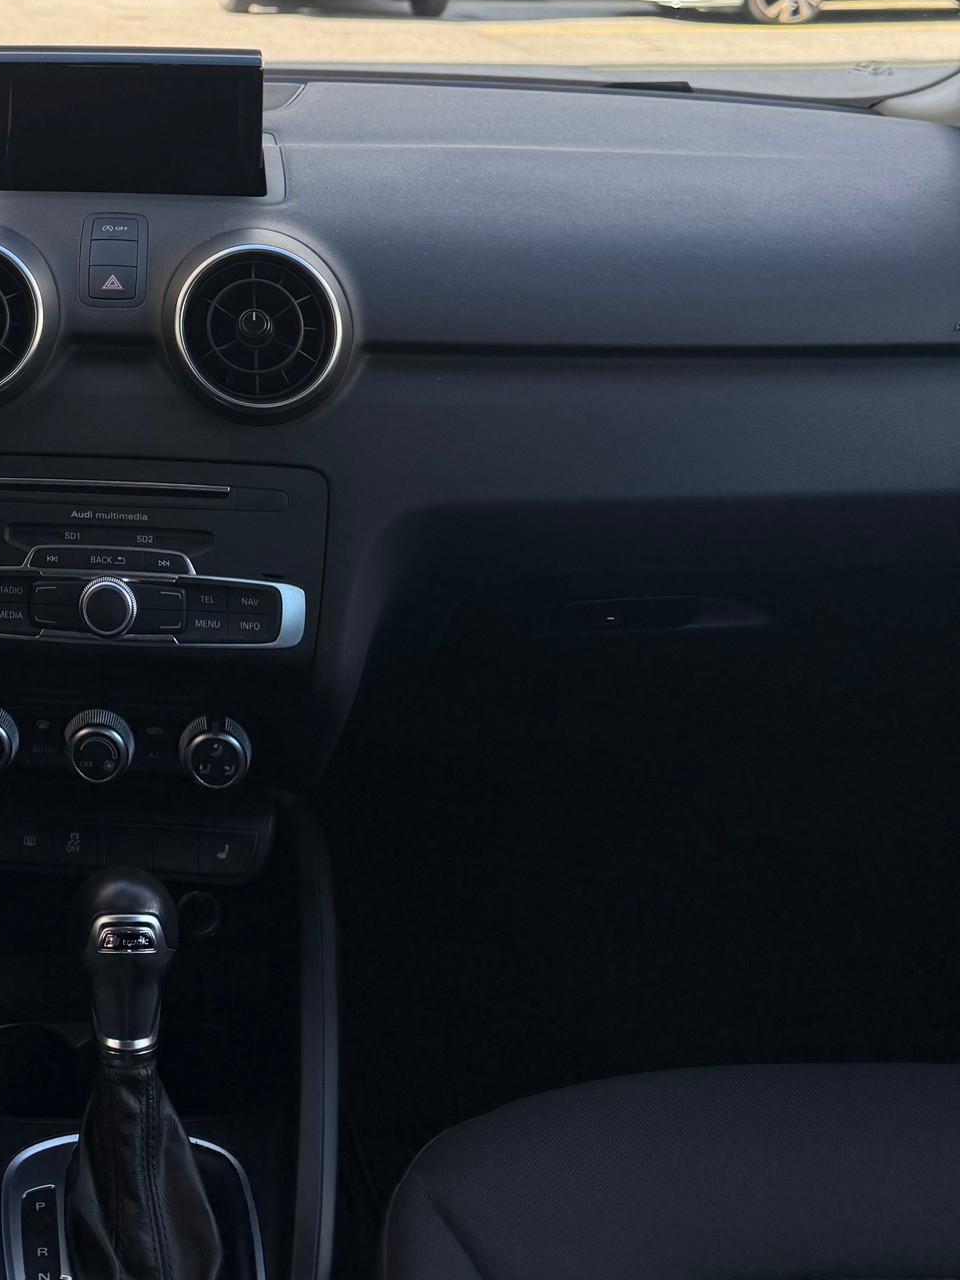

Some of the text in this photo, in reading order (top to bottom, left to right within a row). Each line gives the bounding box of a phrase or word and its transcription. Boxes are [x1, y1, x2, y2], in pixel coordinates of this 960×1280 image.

[70, 509, 149, 521] Audi multimedia
[63, 531, 81, 541] SD1
[135, 534, 154, 544] SD2
[90, 555, 113, 565] BACK
[199, 594, 215, 604] TEL
[240, 596, 259, 607] NAV
[194, 619, 221, 630] MENU
[239, 620, 261, 631] INFO
[31, 745, 55, 754] AUTO
[80, 760, 93, 768] OFF
[65, 844, 81, 853] OFF
[35, 1201, 46, 1212] P
[36, 1247, 49, 1257] R
[37, 1272, 51, 1280] N
